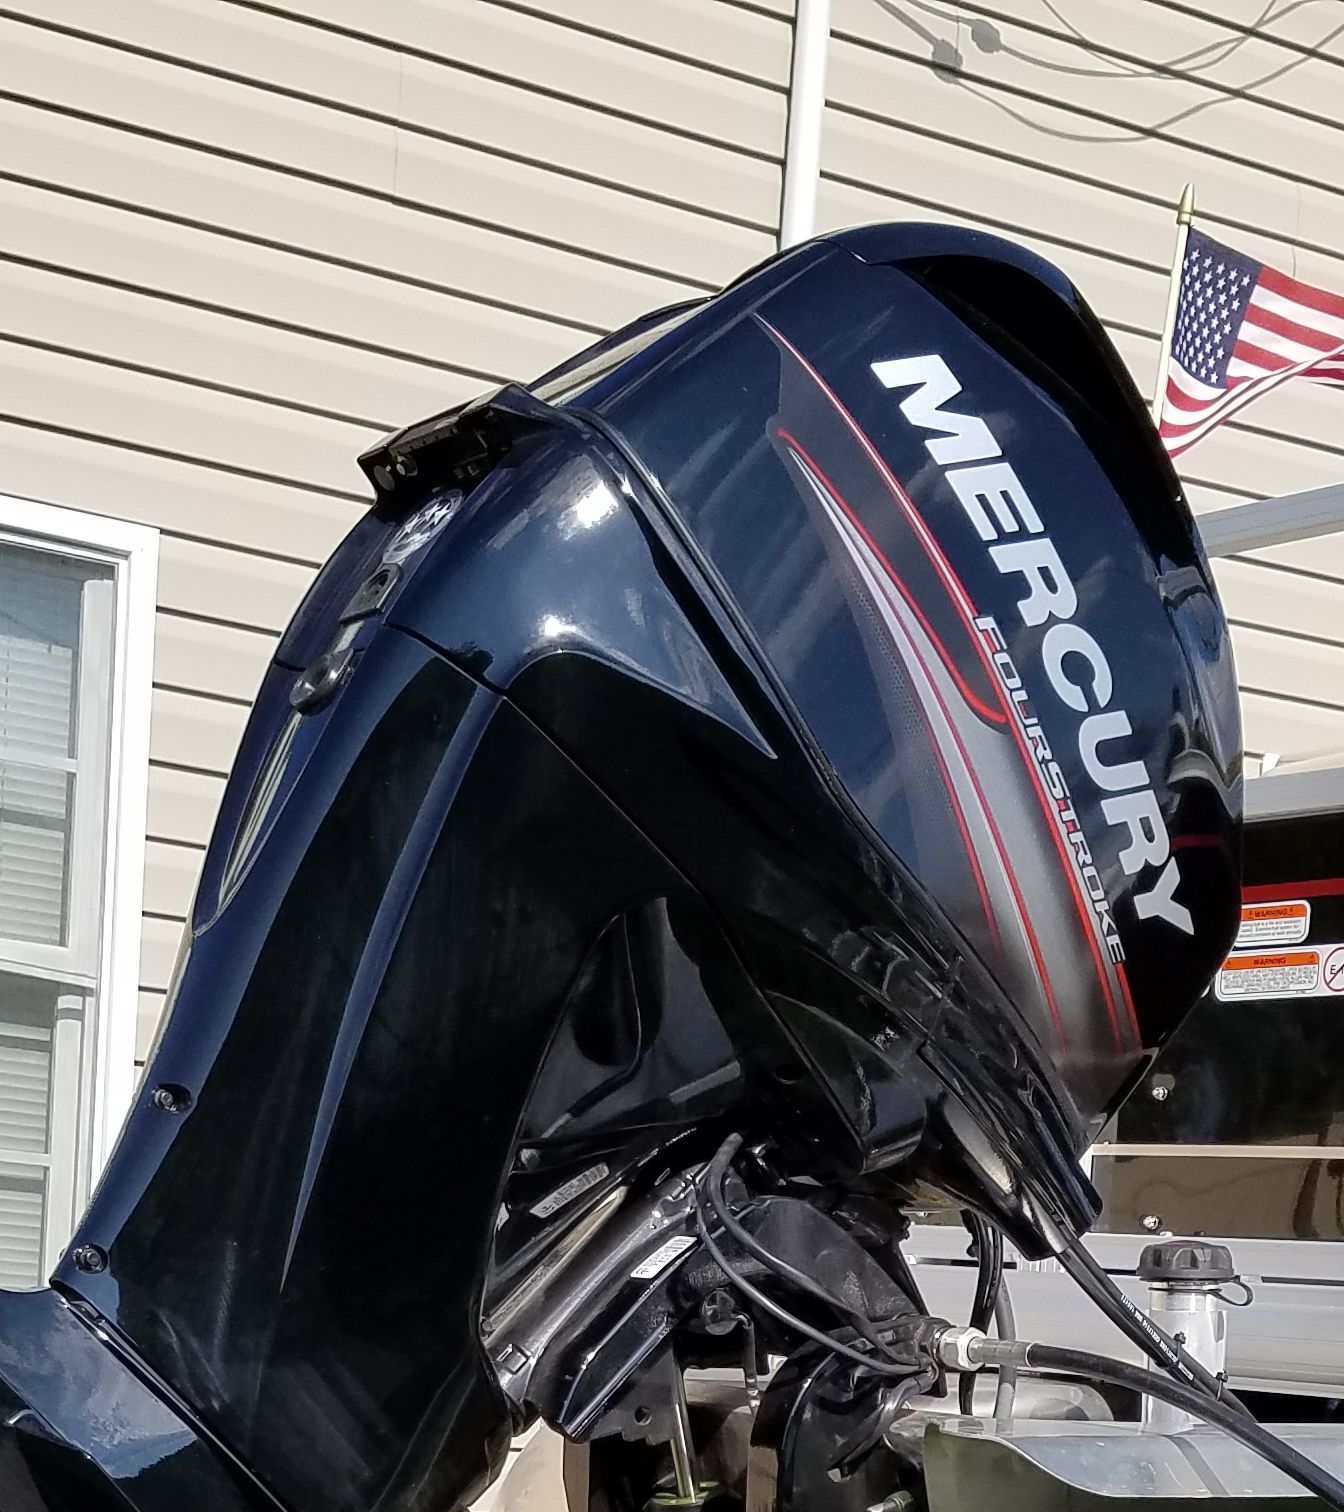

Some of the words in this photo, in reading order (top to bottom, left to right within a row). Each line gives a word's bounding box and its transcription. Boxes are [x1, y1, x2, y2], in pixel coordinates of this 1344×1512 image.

[871, 354, 1194, 935] MERCURY
[974, 615, 1126, 964] FOURSTROKE
[1253, 957, 1287, 966] WARNING
